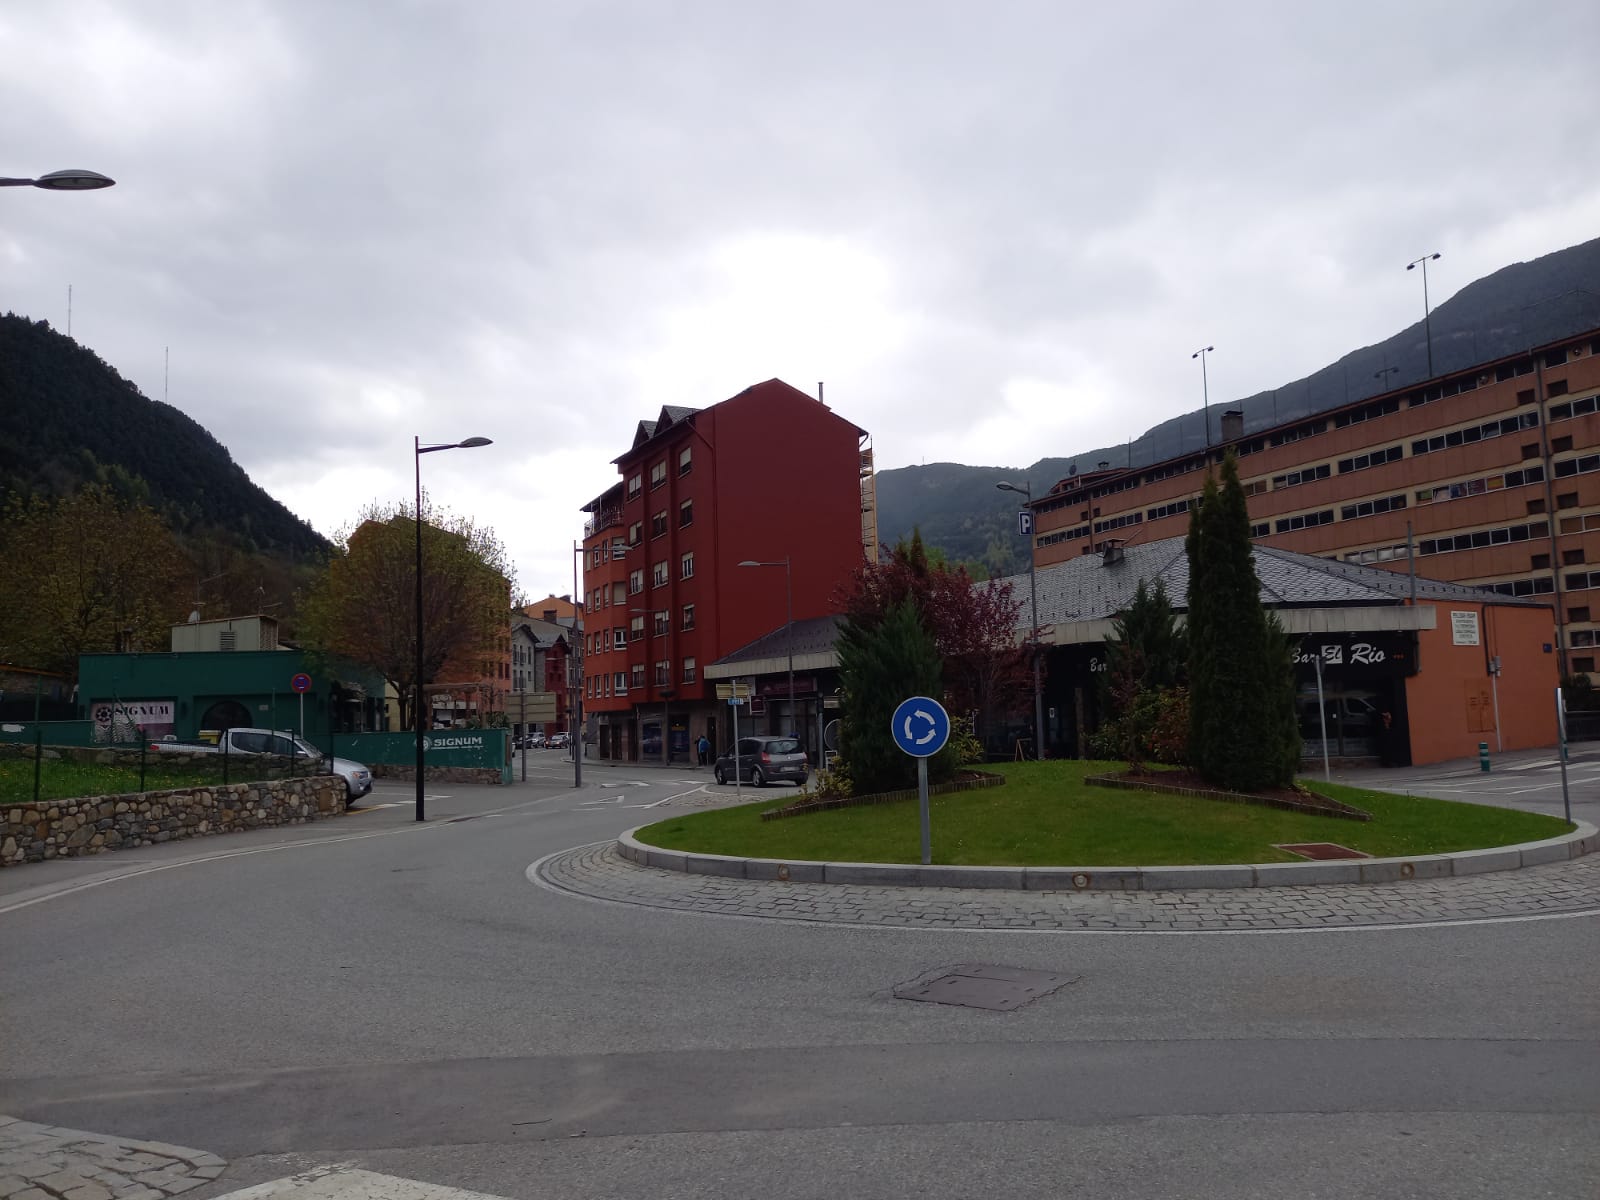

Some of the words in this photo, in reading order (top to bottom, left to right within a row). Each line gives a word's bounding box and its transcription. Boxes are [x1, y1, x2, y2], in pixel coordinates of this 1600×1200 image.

[1021, 514, 1031, 533] P
[1325, 646, 1341, 661] El
[115, 705, 169, 716] SIGNUM
[433, 736, 483, 747] SIGNUM
